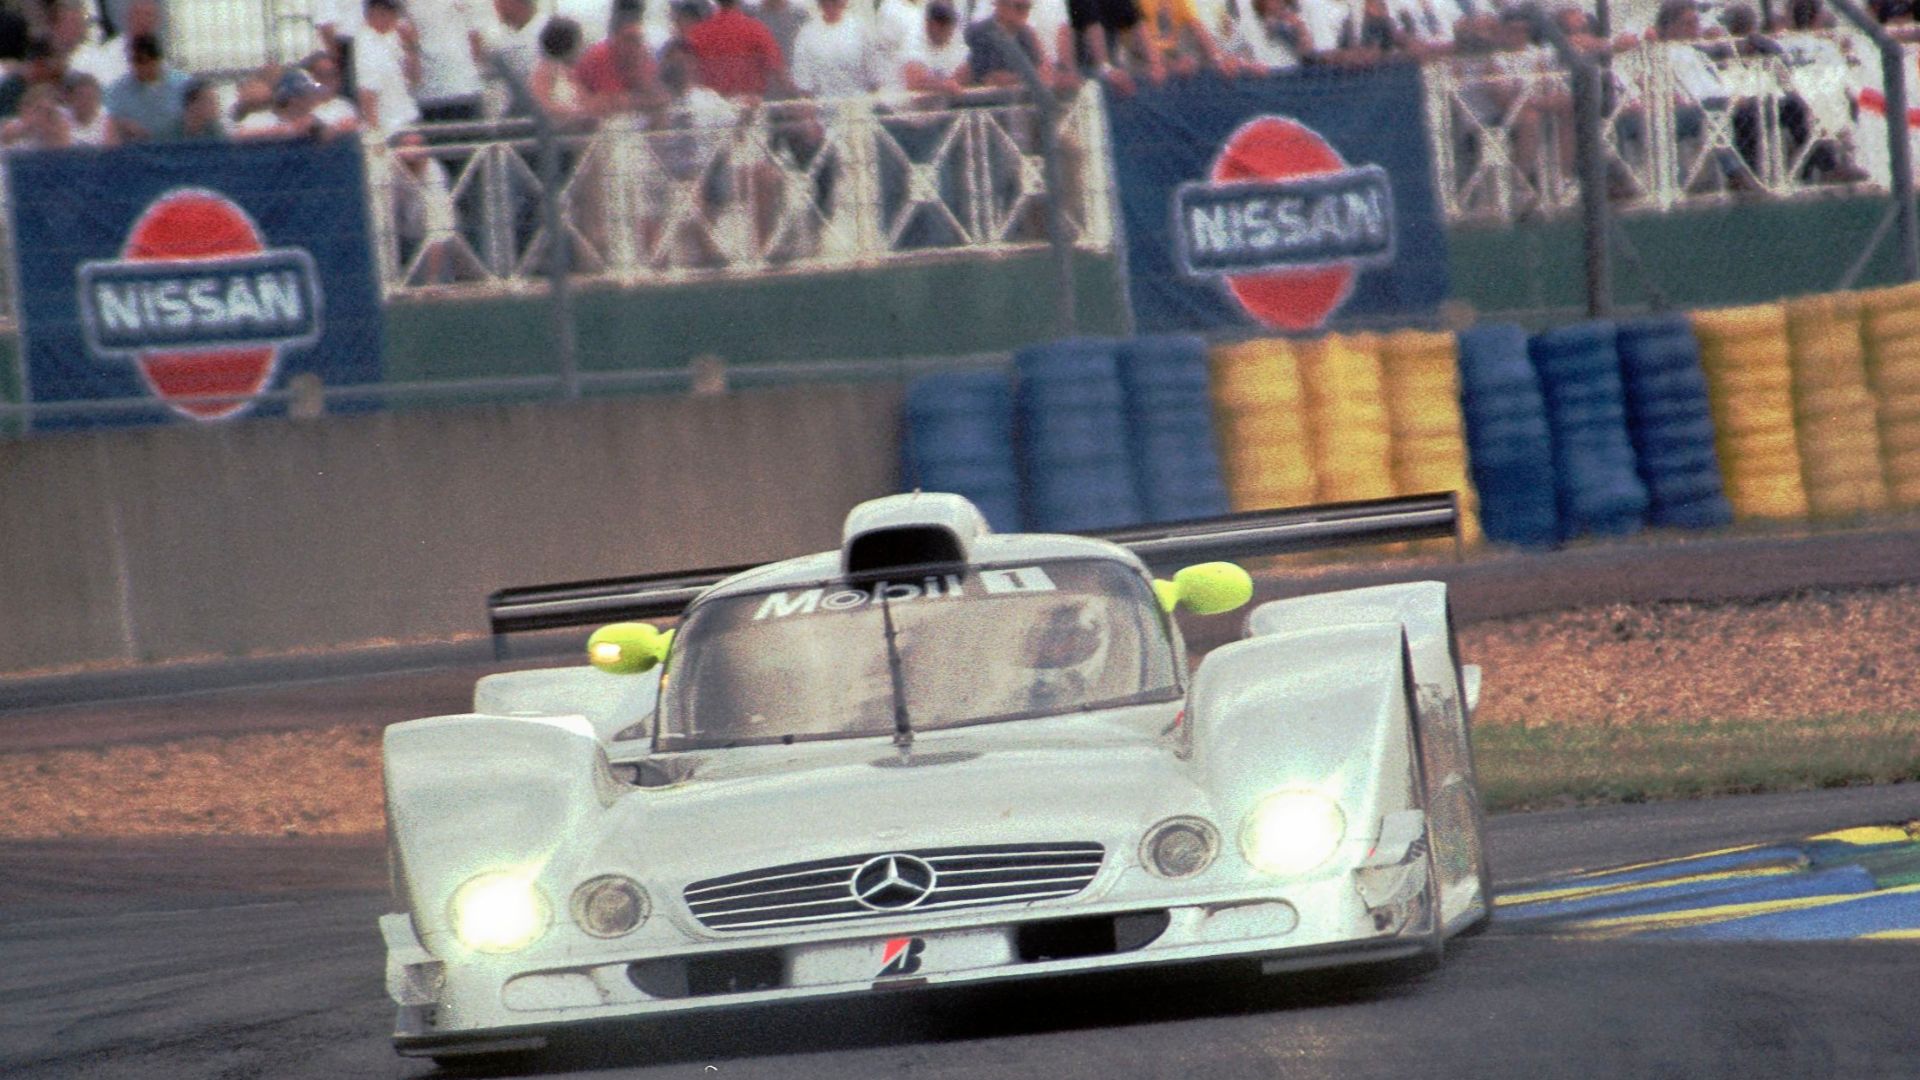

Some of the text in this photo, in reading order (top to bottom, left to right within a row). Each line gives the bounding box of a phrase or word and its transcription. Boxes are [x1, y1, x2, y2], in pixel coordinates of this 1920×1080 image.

[1191, 188, 1382, 250] NISSAN
[97, 271, 300, 330] NISSAN
[753, 574, 963, 621] Mobil
